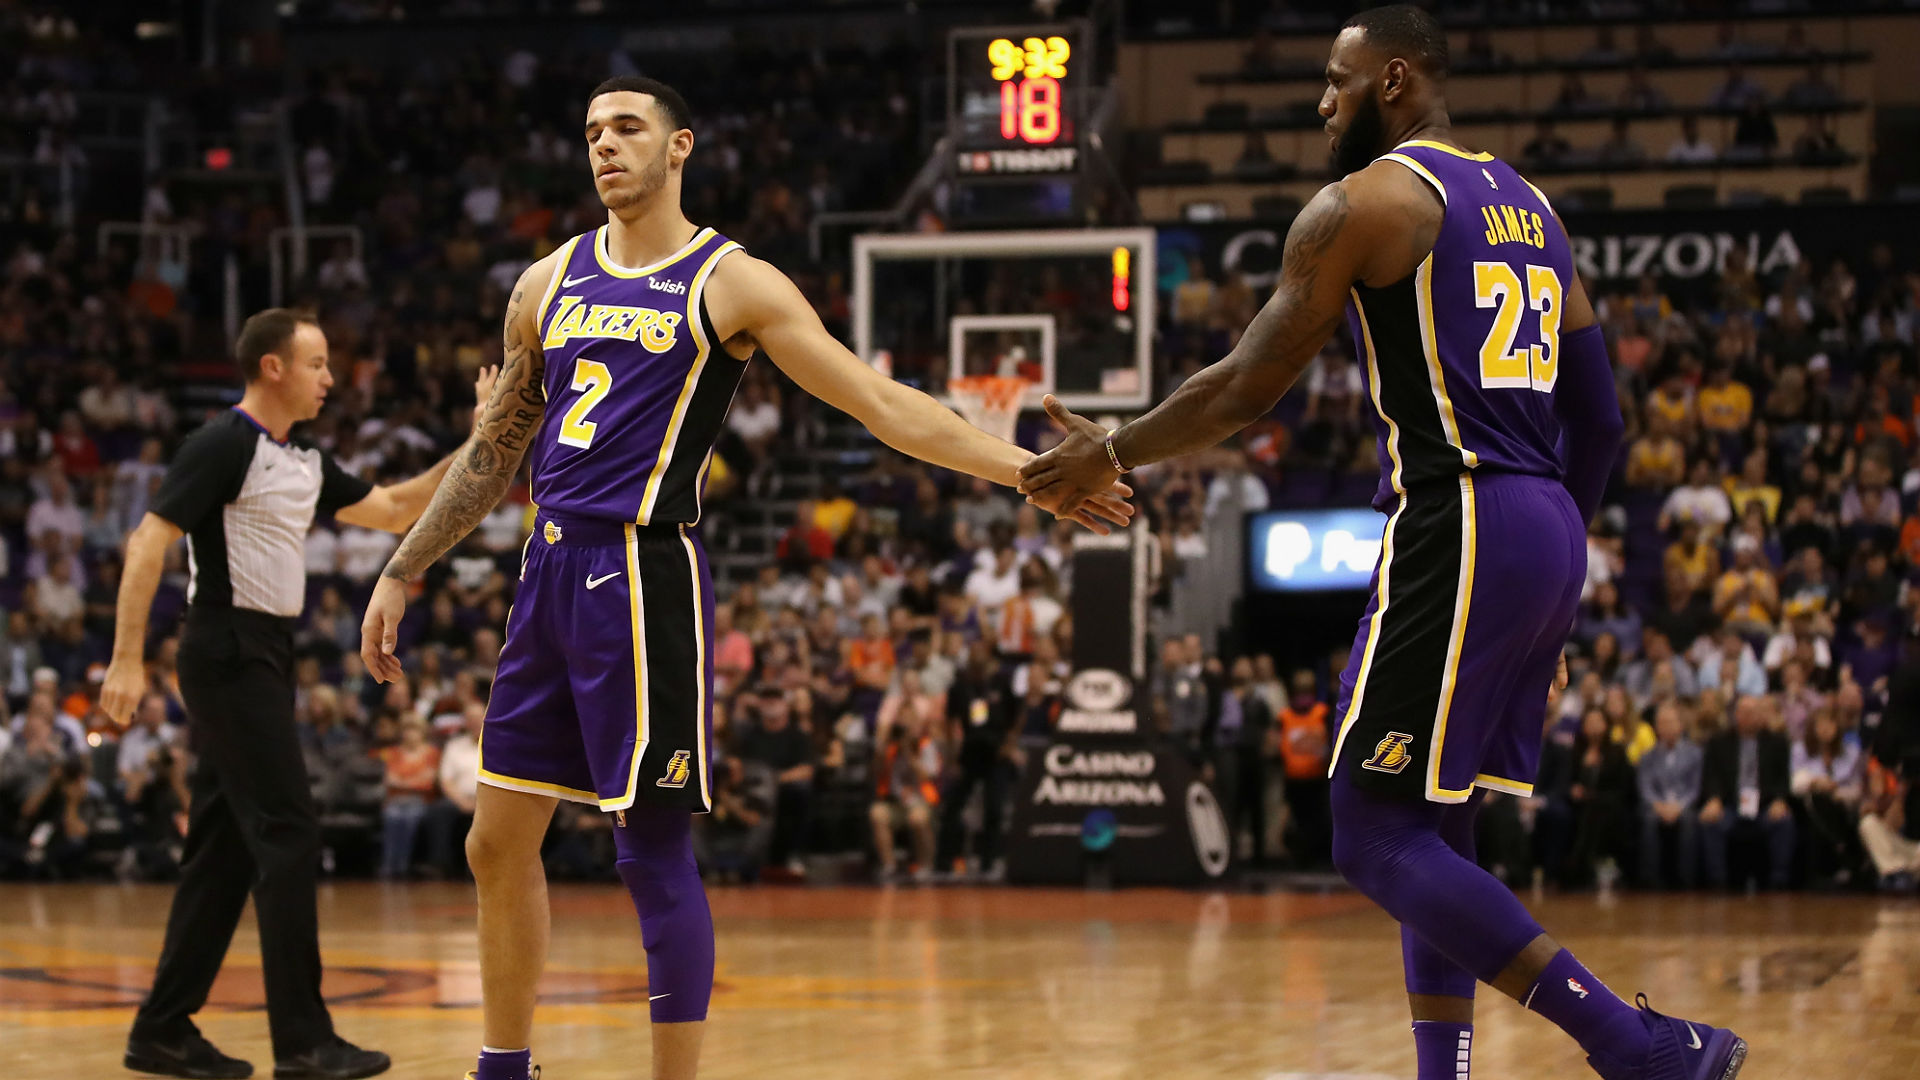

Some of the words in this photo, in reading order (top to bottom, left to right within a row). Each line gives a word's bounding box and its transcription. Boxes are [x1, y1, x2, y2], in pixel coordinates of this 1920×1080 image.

[988, 36, 1070, 80] 9:32
[1001, 76, 1061, 143] 18
[990, 149, 1077, 172] TISSOT
[1481, 204, 1545, 249] JAMES
[1571, 230, 1801, 279] RIZONA
[648, 276, 686, 296] wish
[542, 295, 683, 354] LAKERS
[1473, 261, 1563, 393] 23
[557, 357, 613, 450] 2
[495, 408, 541, 451] FEAR
[1044, 745, 1156, 777] CASINO
[1033, 776, 1165, 805] ARIZONA
